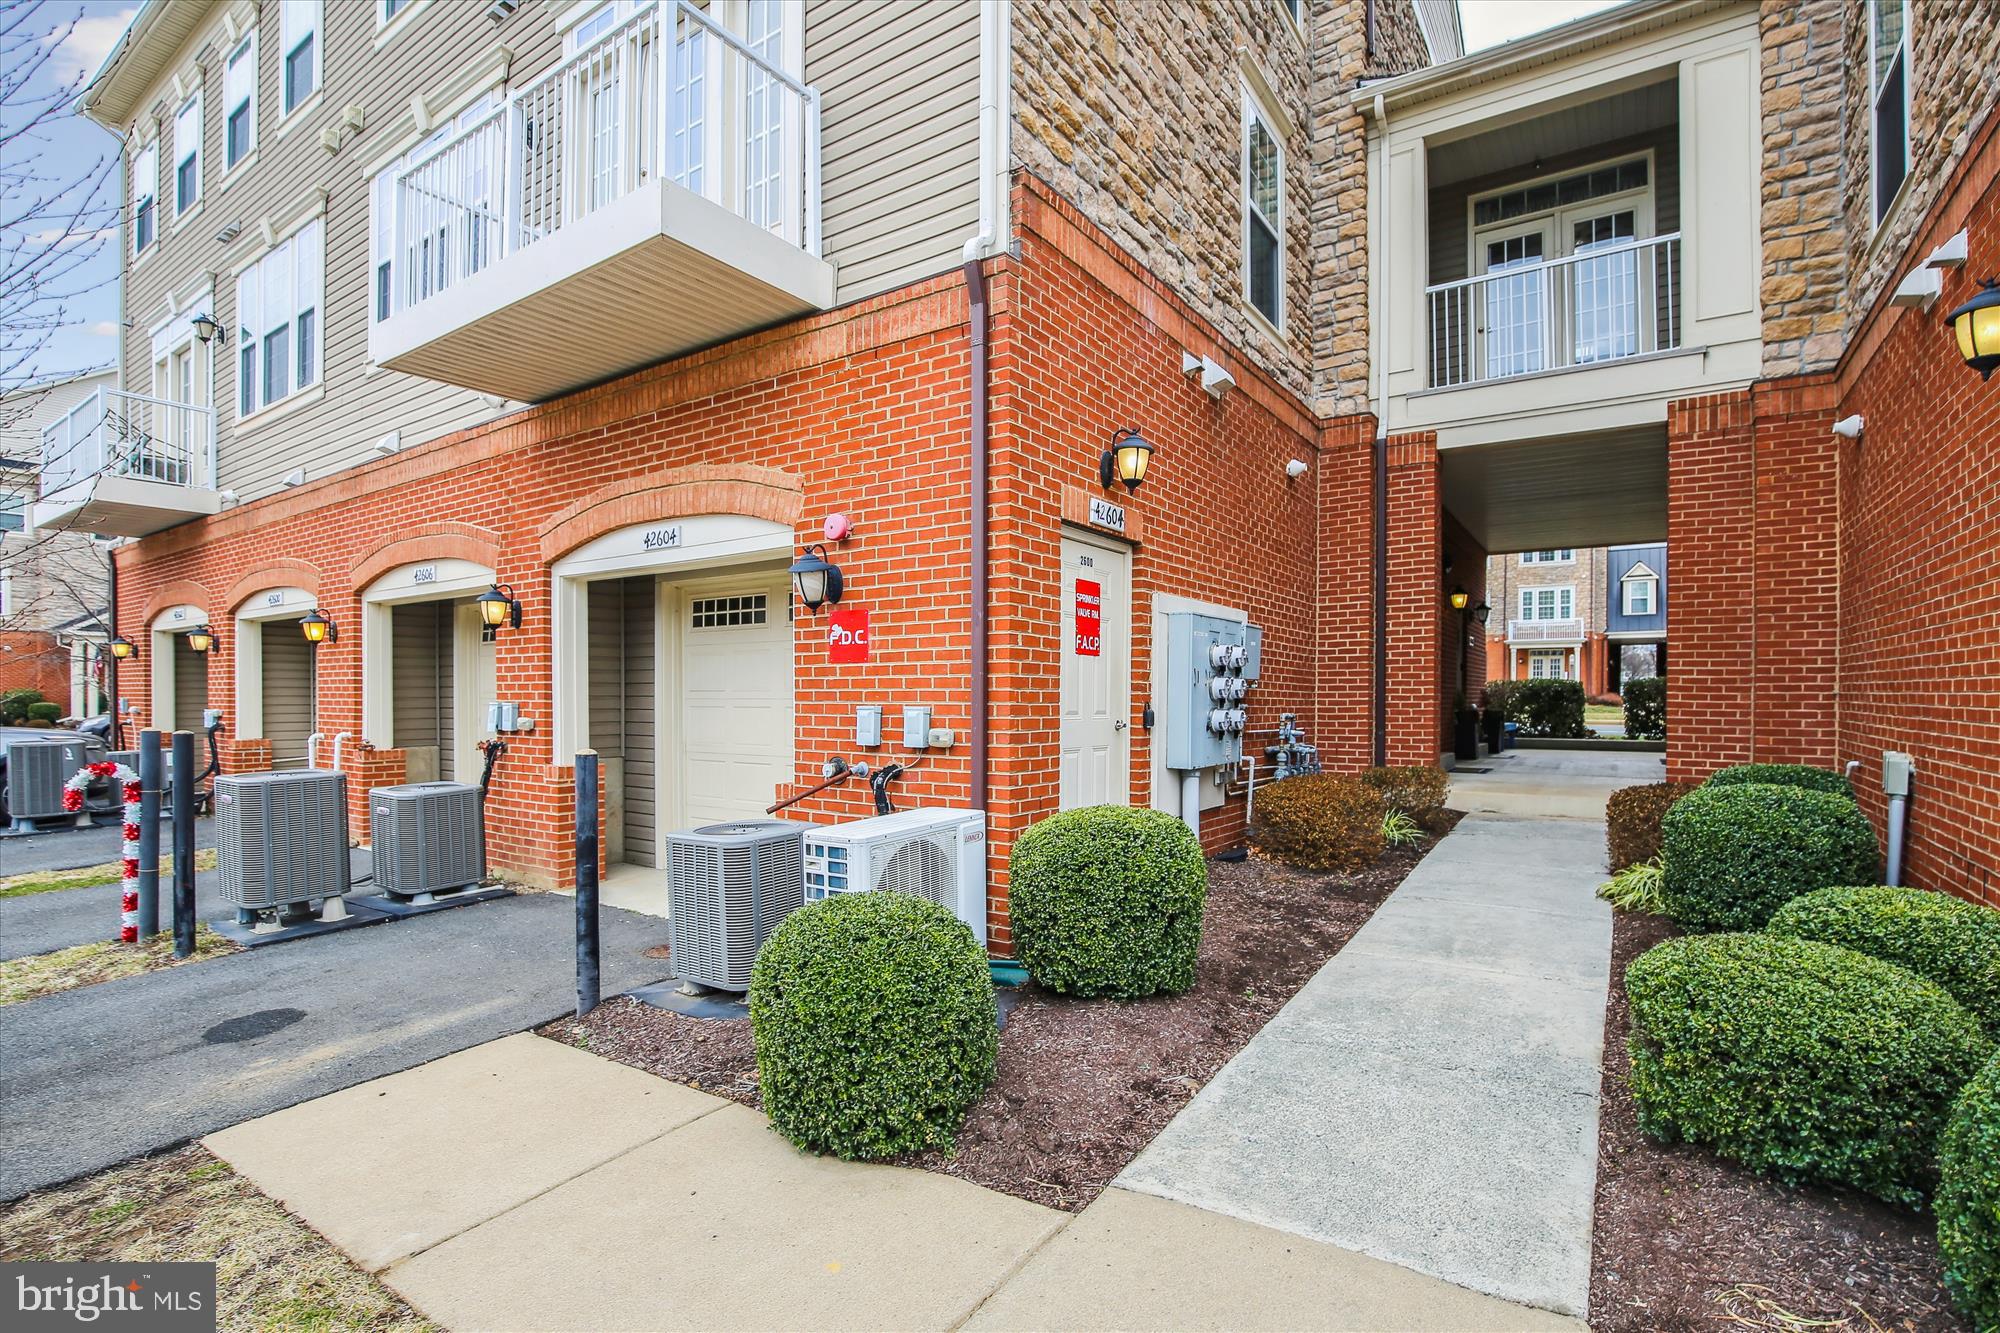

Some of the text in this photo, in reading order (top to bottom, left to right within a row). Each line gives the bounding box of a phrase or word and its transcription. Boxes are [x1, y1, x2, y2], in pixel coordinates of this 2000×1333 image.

[1095, 503, 1124, 527] 42604
[644, 528, 676, 548] 42604
[1081, 556, 1093, 567] 2600
[414, 567, 433, 582] 42606
[1076, 593, 1099, 605] SPRINKLER
[1077, 608, 1091, 618] VALVE
